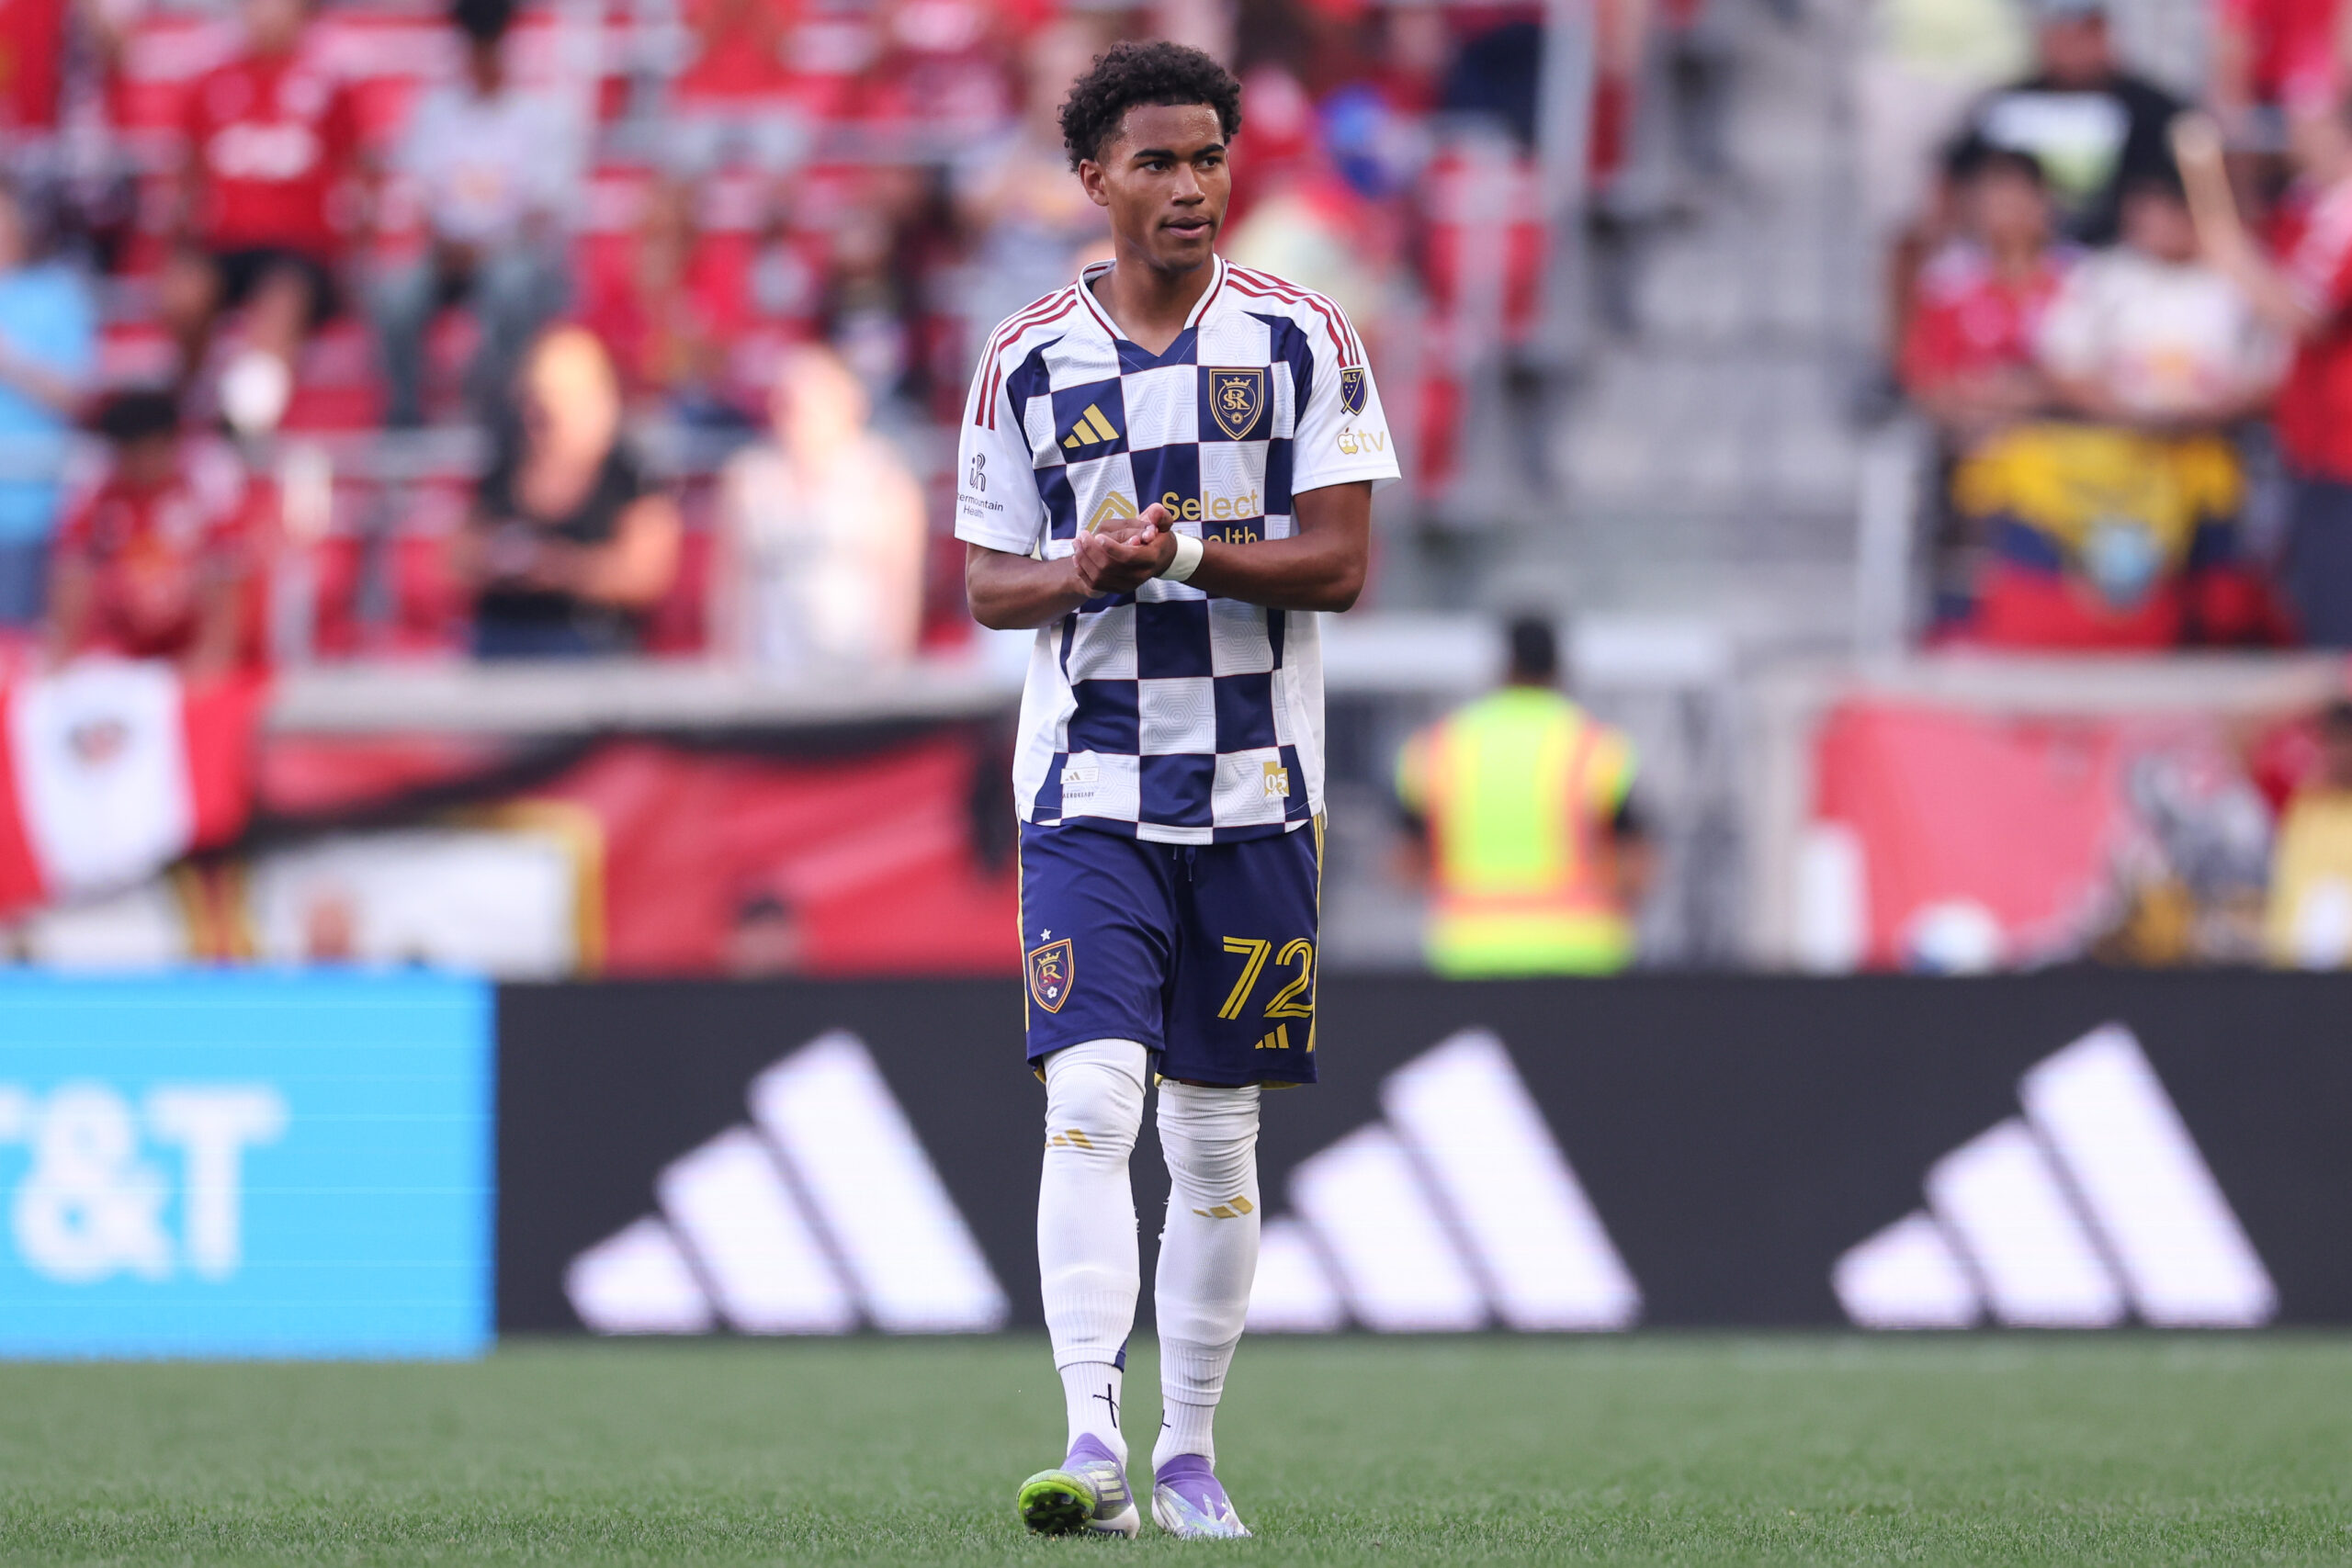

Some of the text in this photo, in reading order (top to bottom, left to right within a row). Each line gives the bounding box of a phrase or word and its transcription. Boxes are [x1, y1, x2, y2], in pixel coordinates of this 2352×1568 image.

[1343, 373, 1357, 383] MLS
[1357, 429, 1385, 453] tv
[956, 492, 1004, 512] ermountain
[1161, 489, 1259, 522] Select
[1217, 935, 1314, 1020] 72
[0, 1083, 289, 1283] &T
